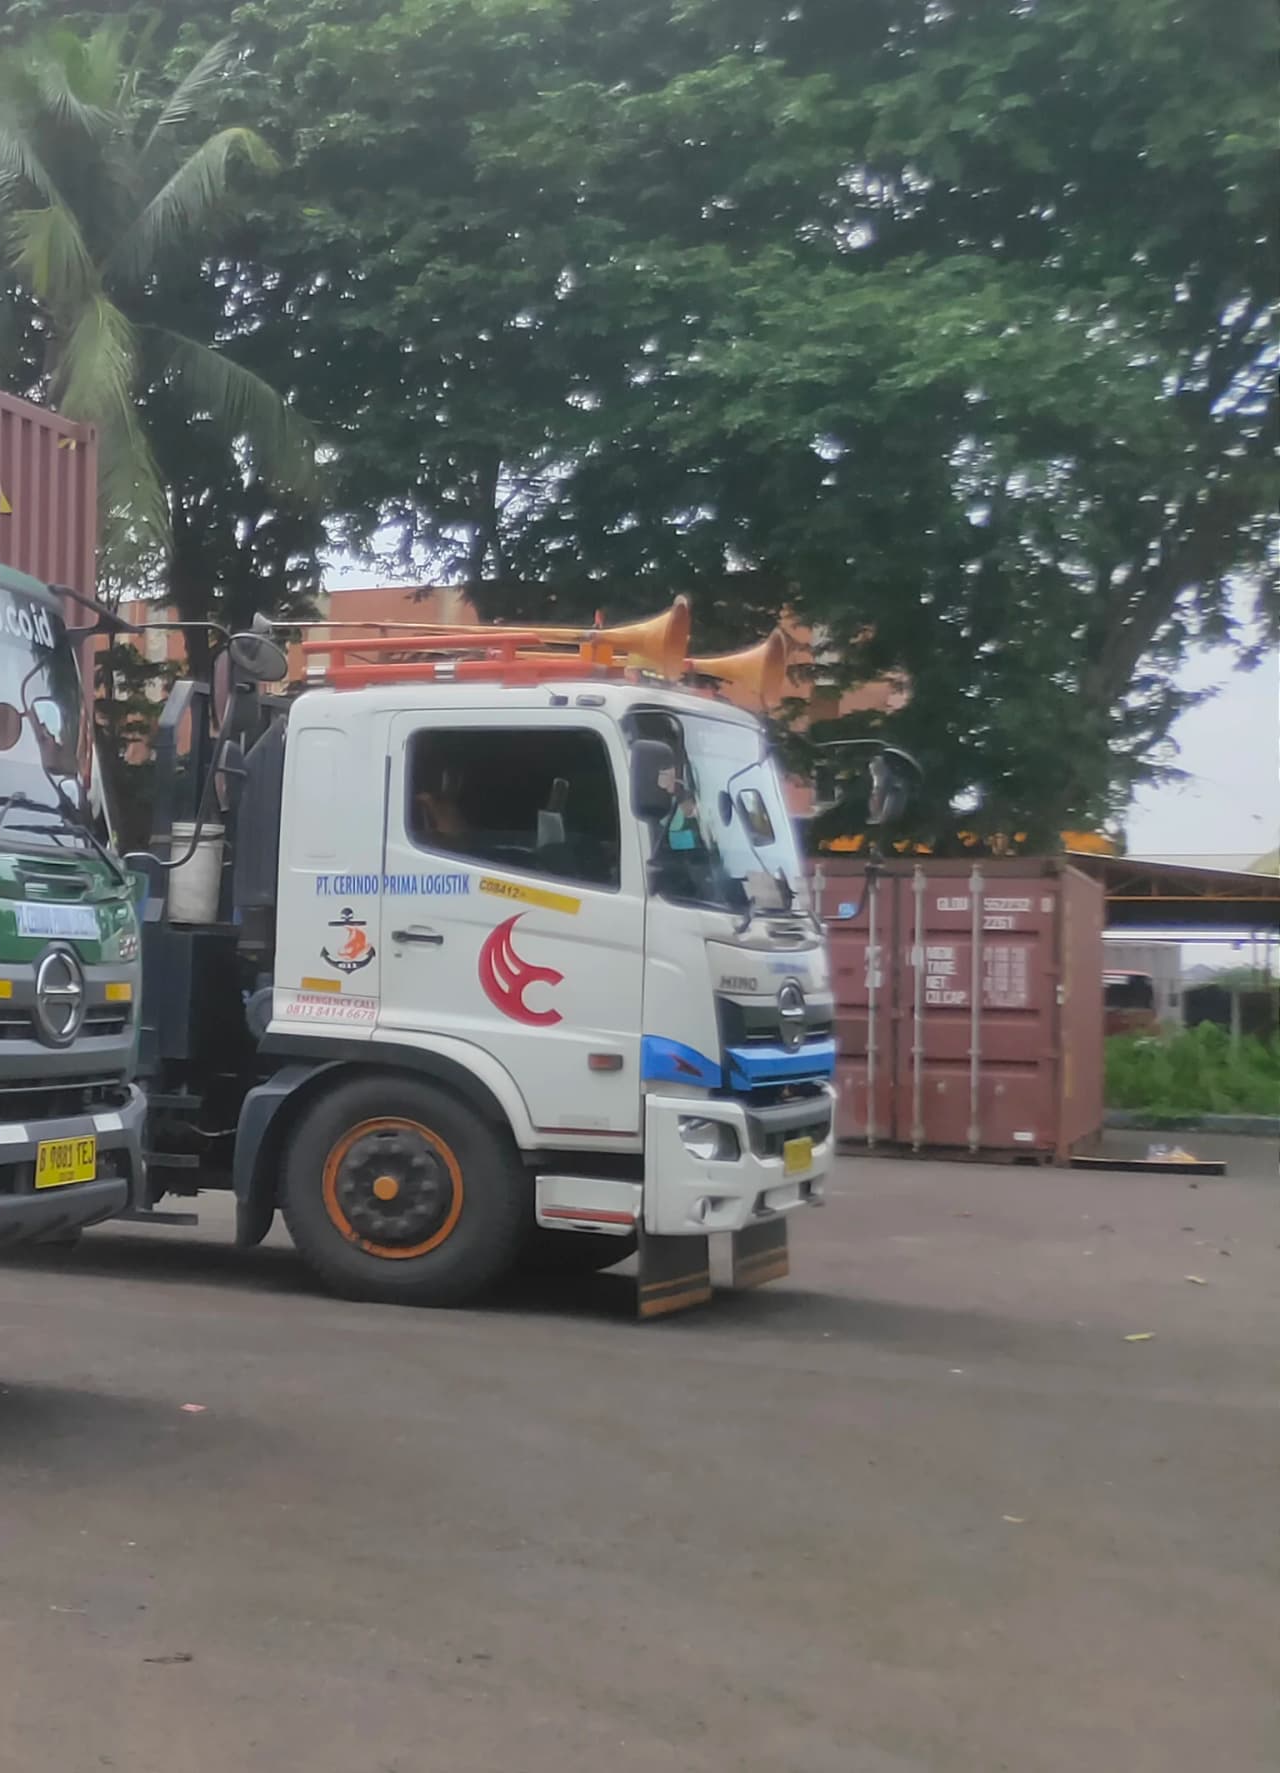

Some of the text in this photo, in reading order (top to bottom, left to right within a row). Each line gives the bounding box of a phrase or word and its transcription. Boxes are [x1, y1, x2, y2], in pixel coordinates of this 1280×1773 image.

[316, 874, 470, 896] PT. CERINDO PRIMA LOGISTIK
[296, 994, 377, 1010] EMERGENCY CALL
[286, 1003, 314, 1017] 0813
[346, 1008, 376, 1020] 6678
